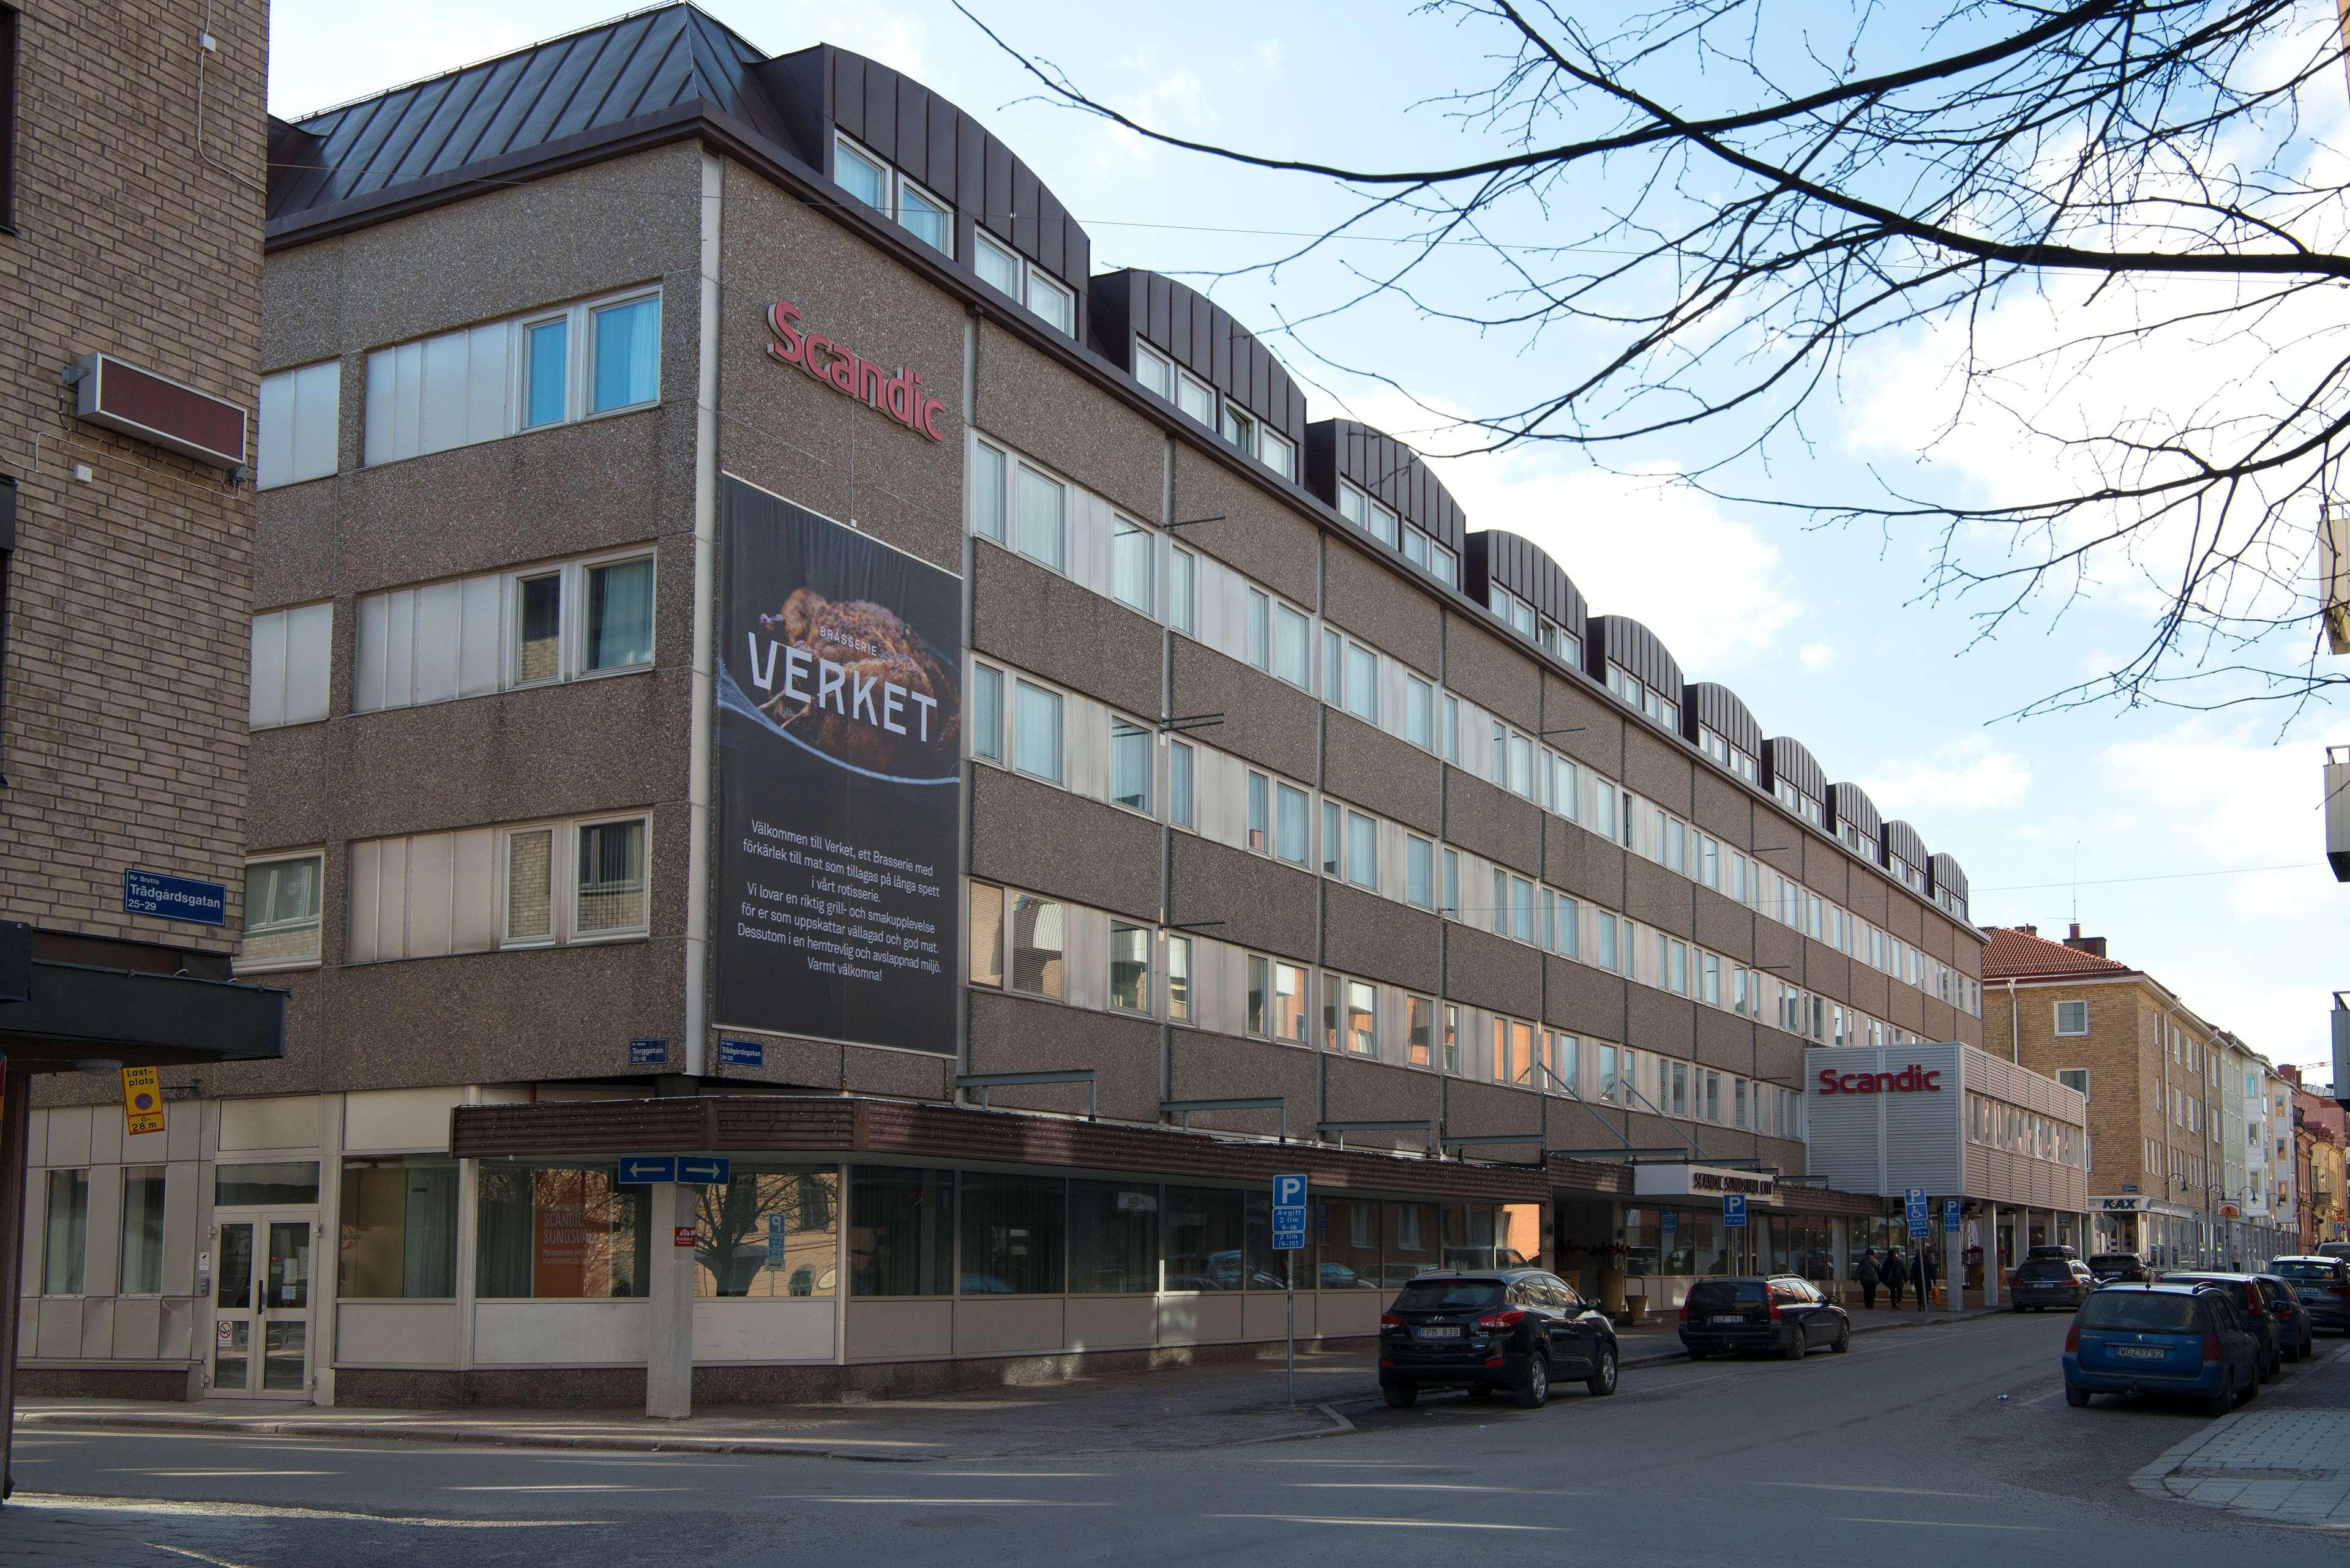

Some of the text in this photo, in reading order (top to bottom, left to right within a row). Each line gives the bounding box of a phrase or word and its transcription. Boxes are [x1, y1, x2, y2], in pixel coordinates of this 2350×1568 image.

[766, 301, 945, 442] Scandic
[820, 626, 877, 657] BRASSERIE
[748, 631, 937, 743] VERKET
[752, 819, 933, 876] Välkommen till Verket, ett Brasserie med
[743, 838, 940, 897] förkärlek till mat som tillagas på långa spett
[140, 876, 159, 885] Brutto
[812, 875, 881, 903] i vårt rotisserie.
[128, 898, 157, 911] 25-29
[130, 883, 220, 908] Trädgårdsgatan
[747, 881, 935, 934] Vi lovar en riktig grill- och smakupplevelse
[741, 902, 939, 954] för er som uppskattar vällagad och god mat.
[738, 922, 941, 975] Dessutom i en hemtrevlig och avslappnad miljö.
[807, 956, 882, 981] Varmt välkomna!
[721, 1046, 761, 1057] Trädgårdsgatan
[127, 1068, 154, 1077] Last-
[129, 1078, 154, 1088] plats
[1819, 1064, 1941, 1094] Scandic
[132, 1122, 146, 1131] 28
[1282, 1178, 1300, 1204] P
[1693, 1172, 1773, 1195] SCANDIC SUNDSVALL CITY
[1729, 1197, 1742, 1213] P
[1910, 1189, 1921, 1203] P
[1948, 1201, 1957, 1212] P
[544, 1212, 584, 1227] SCANDIC
[1421, 1328, 1437, 1337] FPM
[2120, 1347, 2163, 1357] WGZ 792
